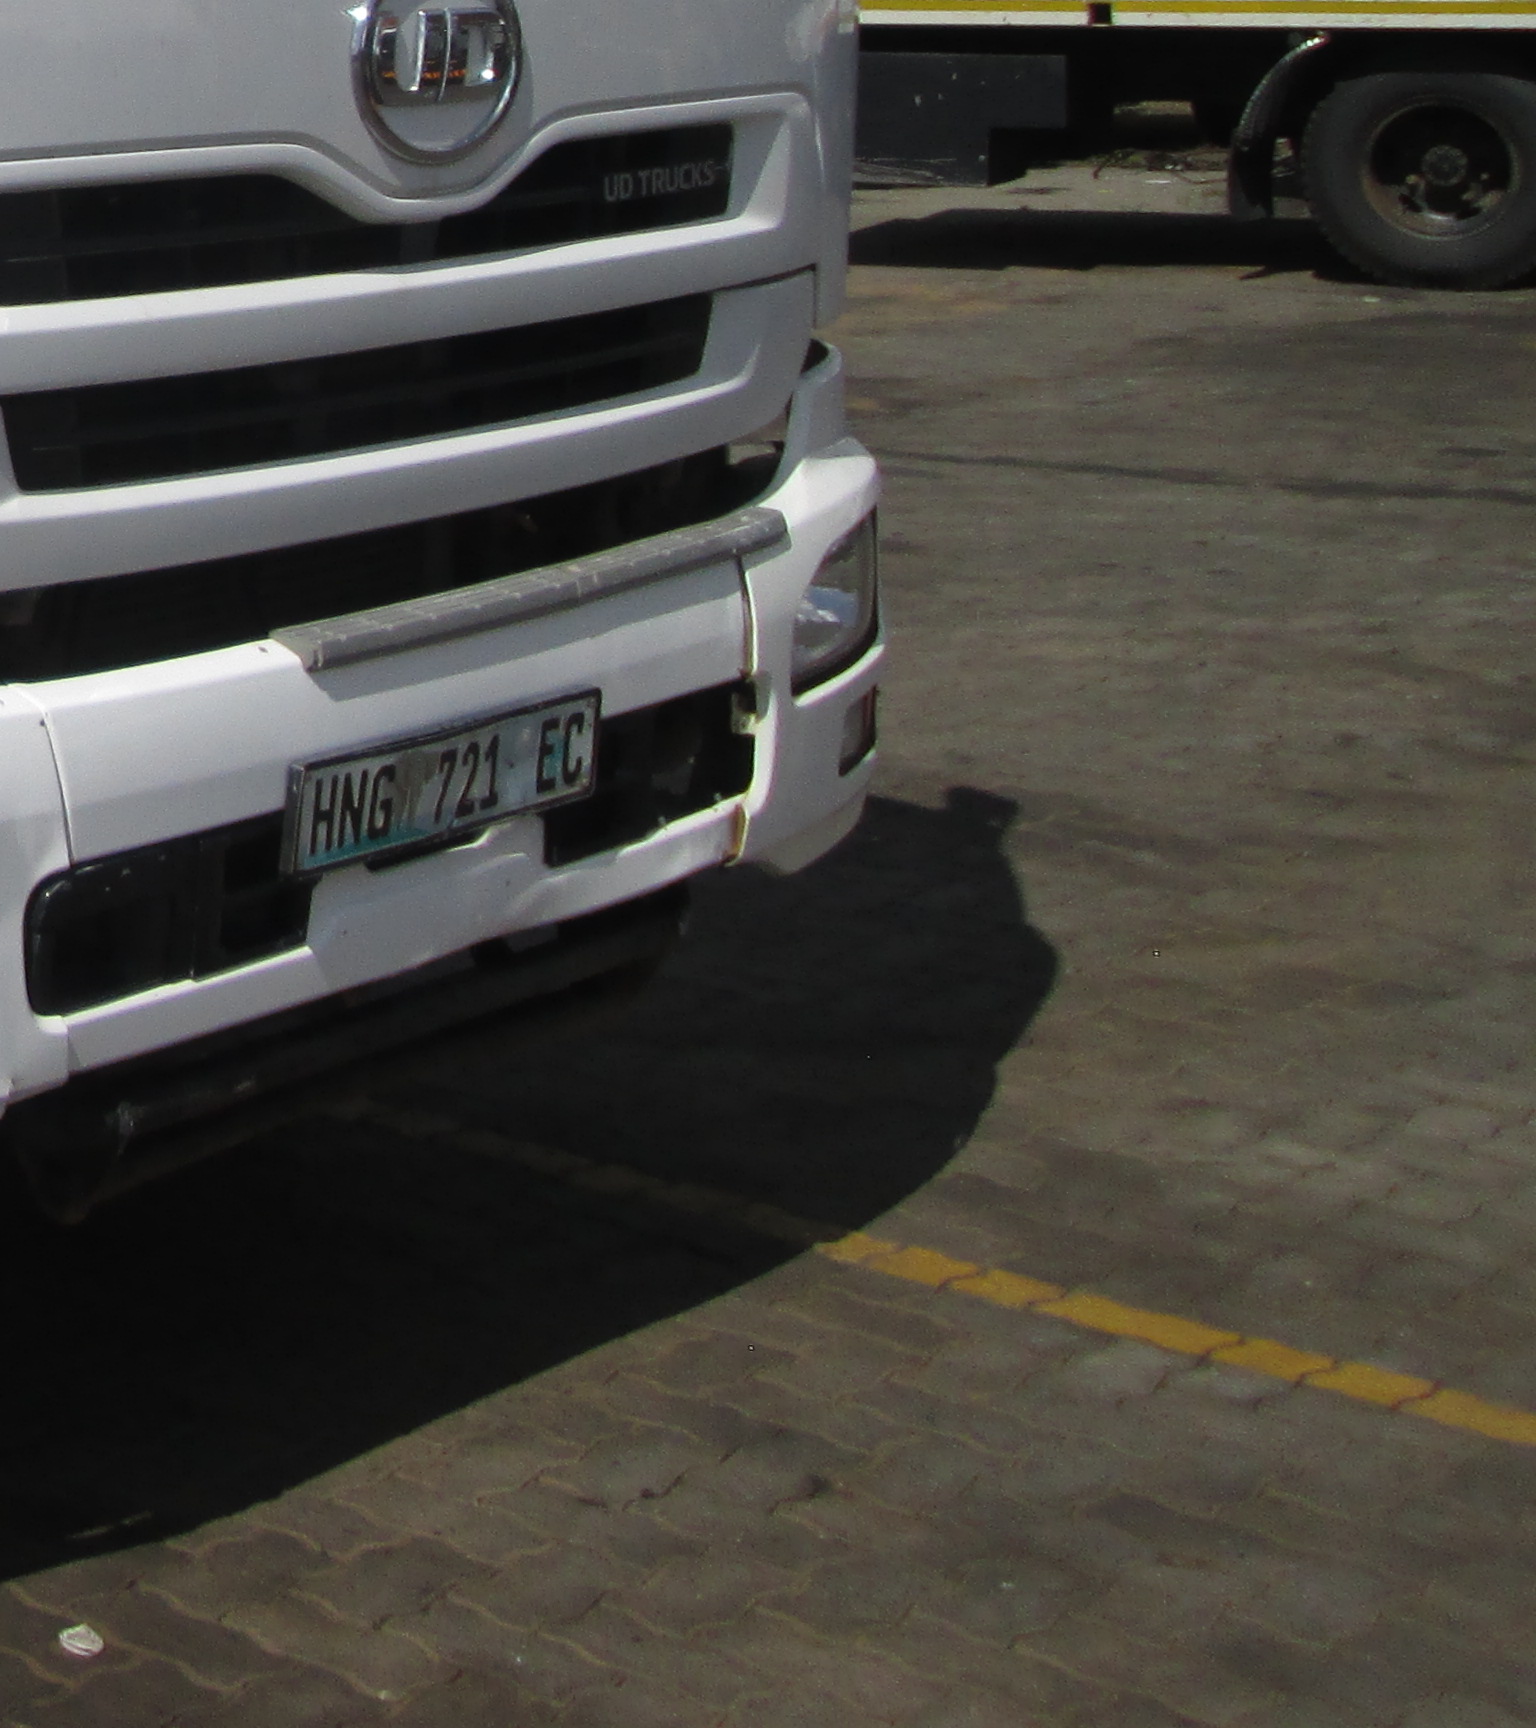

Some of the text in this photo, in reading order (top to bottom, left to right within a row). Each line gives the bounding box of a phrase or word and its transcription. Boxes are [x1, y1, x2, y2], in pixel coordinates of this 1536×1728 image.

[602, 159, 716, 203] UD TRUCKS
[308, 712, 586, 857] HNG 721 EC
